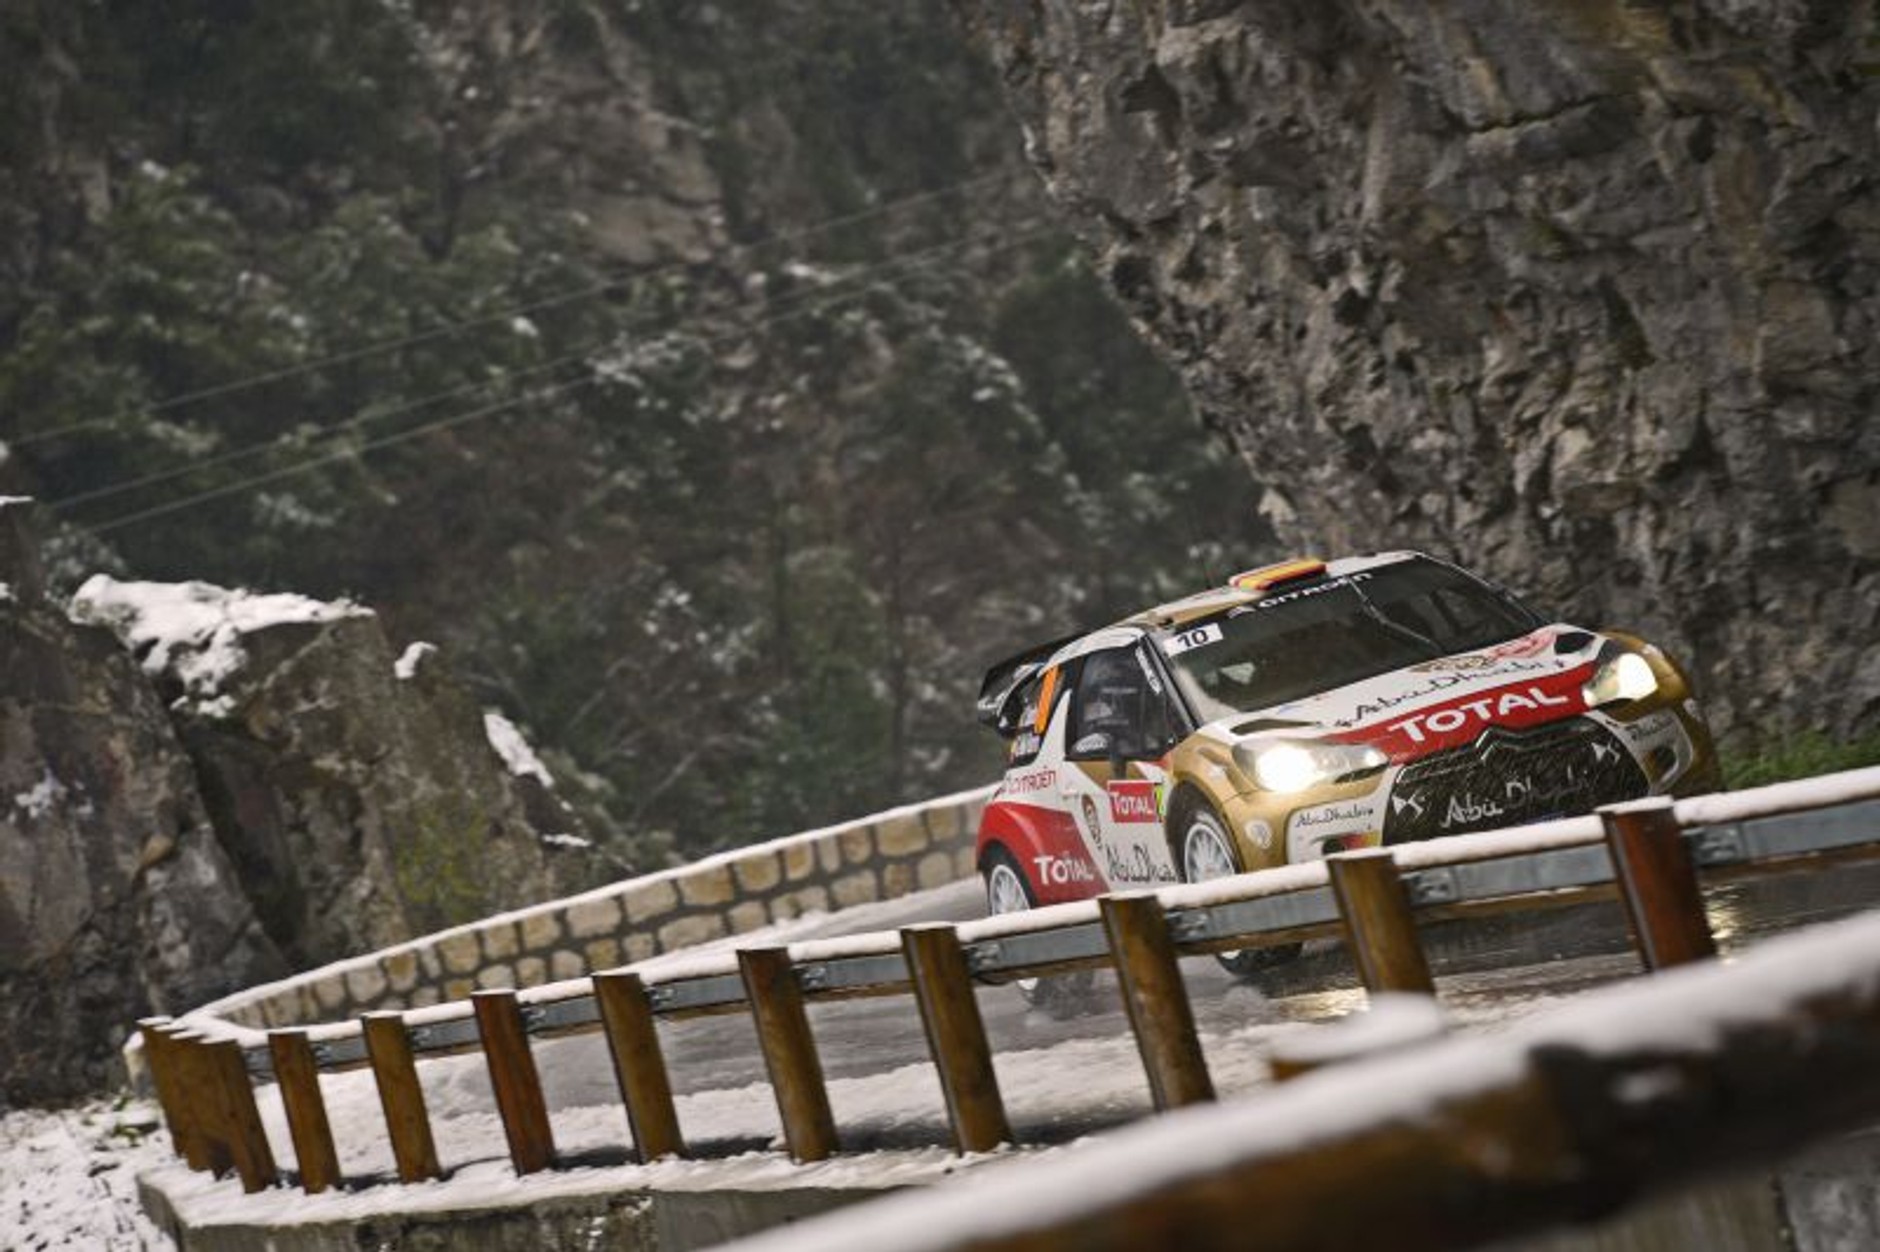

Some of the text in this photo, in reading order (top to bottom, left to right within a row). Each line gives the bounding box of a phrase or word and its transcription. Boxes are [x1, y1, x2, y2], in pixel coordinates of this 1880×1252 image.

[1177, 629, 1209, 650] 10
[1387, 687, 1568, 743] TOTAL
[1109, 791, 1154, 817] TOTAL
[1438, 793, 1503, 828] Abu
[1033, 854, 1094, 885] TOTAL
